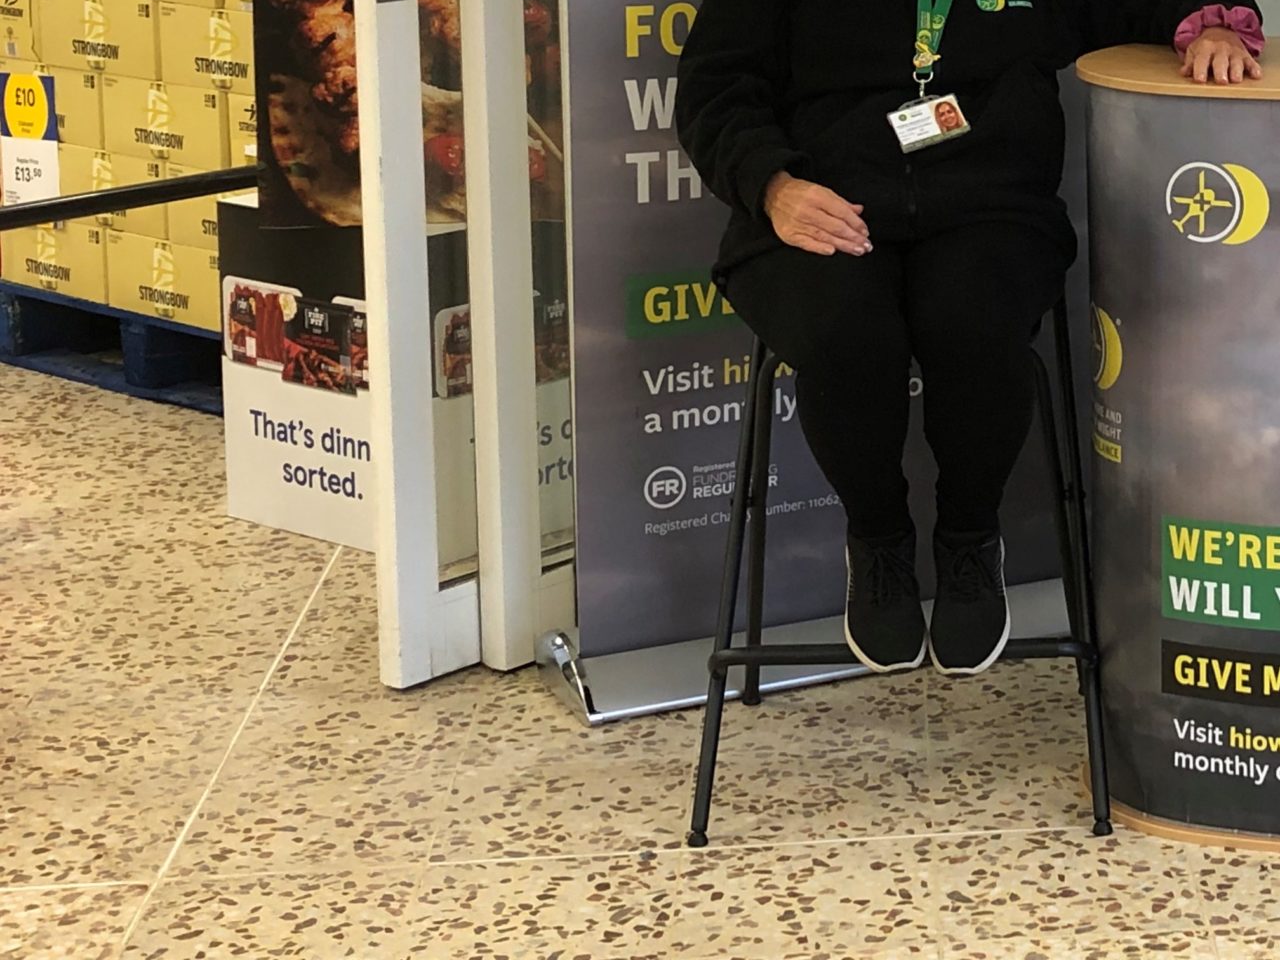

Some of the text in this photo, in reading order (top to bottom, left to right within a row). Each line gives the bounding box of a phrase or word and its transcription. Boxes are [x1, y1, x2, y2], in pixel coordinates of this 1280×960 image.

[625, 2, 699, 58] FO
[72, 39, 120, 60] STRONGBOW
[194, 56, 249, 79] STRONGBOW
[15, 88, 36, 108] £10
[134, 127, 184, 150] STRONGBOW
[15, 166, 42, 183] £13.50
[25, 258, 71, 282] STRONGBOW
[139, 285, 190, 310] STRONGBOW
[644, 281, 735, 324] GIV
[643, 362, 715, 396] Visit
[250, 409, 371, 462] That's dinn
[643, 413, 662, 434] a
[282, 461, 364, 500] sorted.
[651, 478, 680, 499] FR
[644, 513, 708, 536] Registered
[765, 500, 806, 516] umber:
[1168, 575, 1261, 621] WILL
[1174, 653, 1252, 694] GIVE
[1173, 718, 1224, 746] Visit
[1173, 751, 1270, 786] monthly
